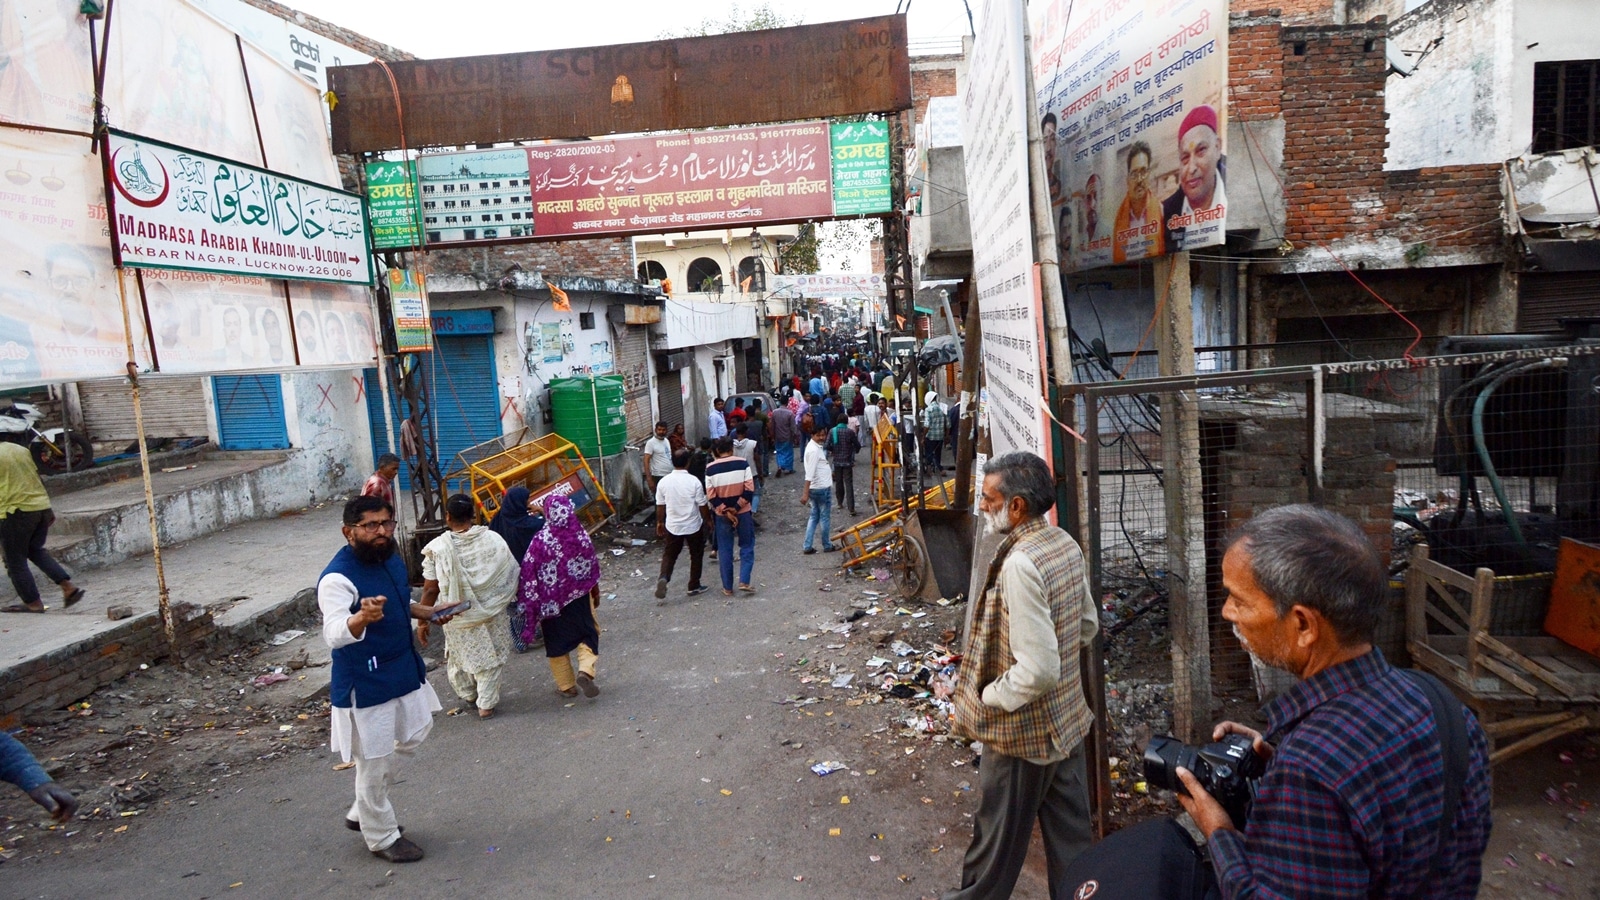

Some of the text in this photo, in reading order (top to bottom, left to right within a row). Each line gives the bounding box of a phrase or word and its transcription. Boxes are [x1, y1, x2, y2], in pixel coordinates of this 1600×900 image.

[545, 41, 688, 79] SCHOOL
[1061, 84, 1102, 121] समरसता
[1106, 66, 1130, 92] भोज
[1134, 47, 1153, 76] एवं
[1157, 9, 1212, 59] संगोष्ठी
[1133, 78, 1151, 97] दिन
[1154, 39, 1216, 88] बृहस्पतिवार
[656, 126, 825, 148] Phone: 9839271433, 9161778692,
[1091, 135, 1116, 155] स्वागत
[1118, 123, 1132, 142] एवं
[1134, 99, 1184, 134] अभिनन्दन
[531, 145, 616, 159] Reg:-2820/2002-03
[834, 142, 887, 160] उमरह
[368, 183, 416, 199] उमरह
[576, 192, 605, 213] अहले
[607, 194, 641, 216] सुन्नत
[676, 189, 713, 206] इस्लाम
[716, 188, 725, 201] व
[728, 179, 784, 207] मुहम्मदिया
[787, 176, 827, 195] मस्जिद
[572, 219, 603, 230] अकबर
[604, 218, 626, 228] नगर
[669, 213, 684, 223] रोड
[686, 210, 725, 222] महानगर
[1194, 203, 1225, 225] तिवारी
[119, 213, 196, 245] MADRASA
[201, 228, 248, 252] ARABIA
[252, 236, 347, 264] KHADIM-UL-ULOOM
[120, 243, 180, 259] AKBAR
